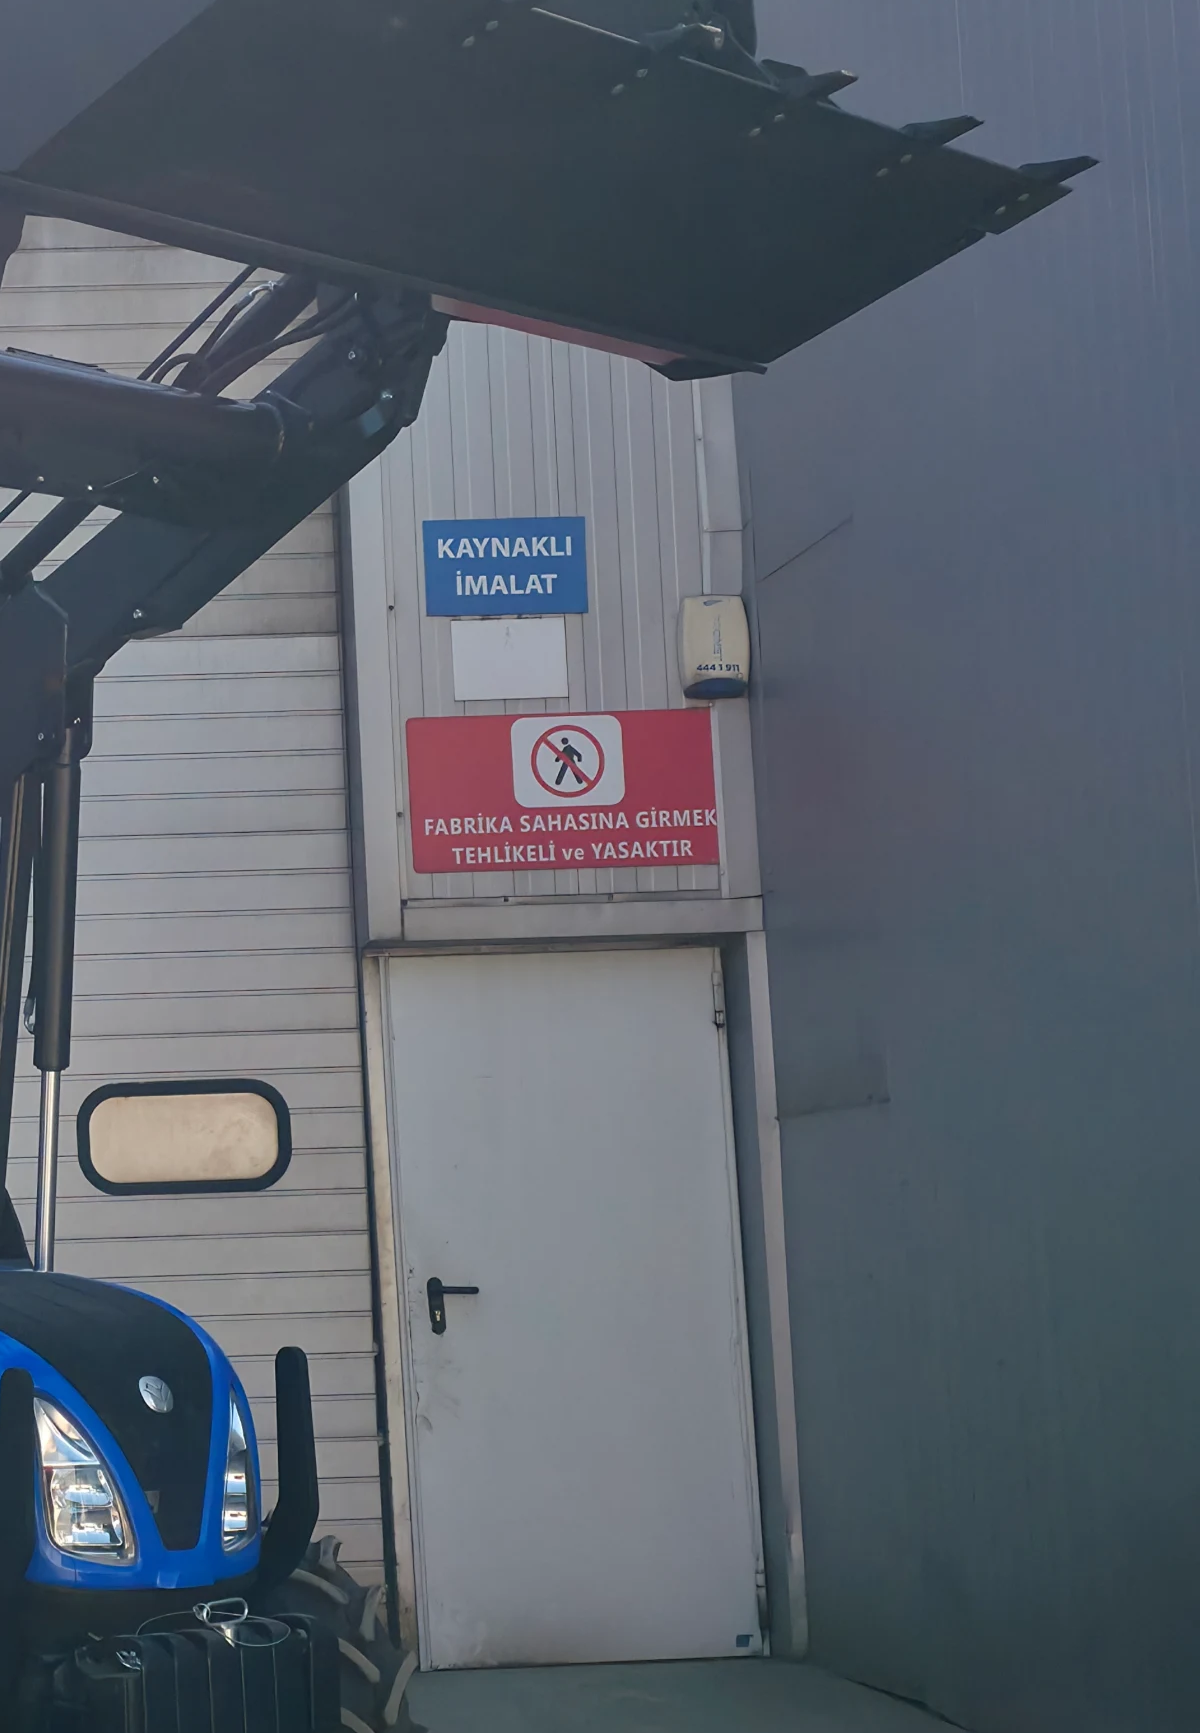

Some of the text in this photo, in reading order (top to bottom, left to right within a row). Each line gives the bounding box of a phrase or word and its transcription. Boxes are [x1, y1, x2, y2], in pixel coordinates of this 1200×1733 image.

[437, 536, 572, 559] KAYNAKLI
[456, 570, 558, 596] İMALAT
[424, 807, 718, 836] FABRİKA SAHASINA GİRMEK
[452, 840, 694, 865] TEHLİKELİ ve YASAKTIR
